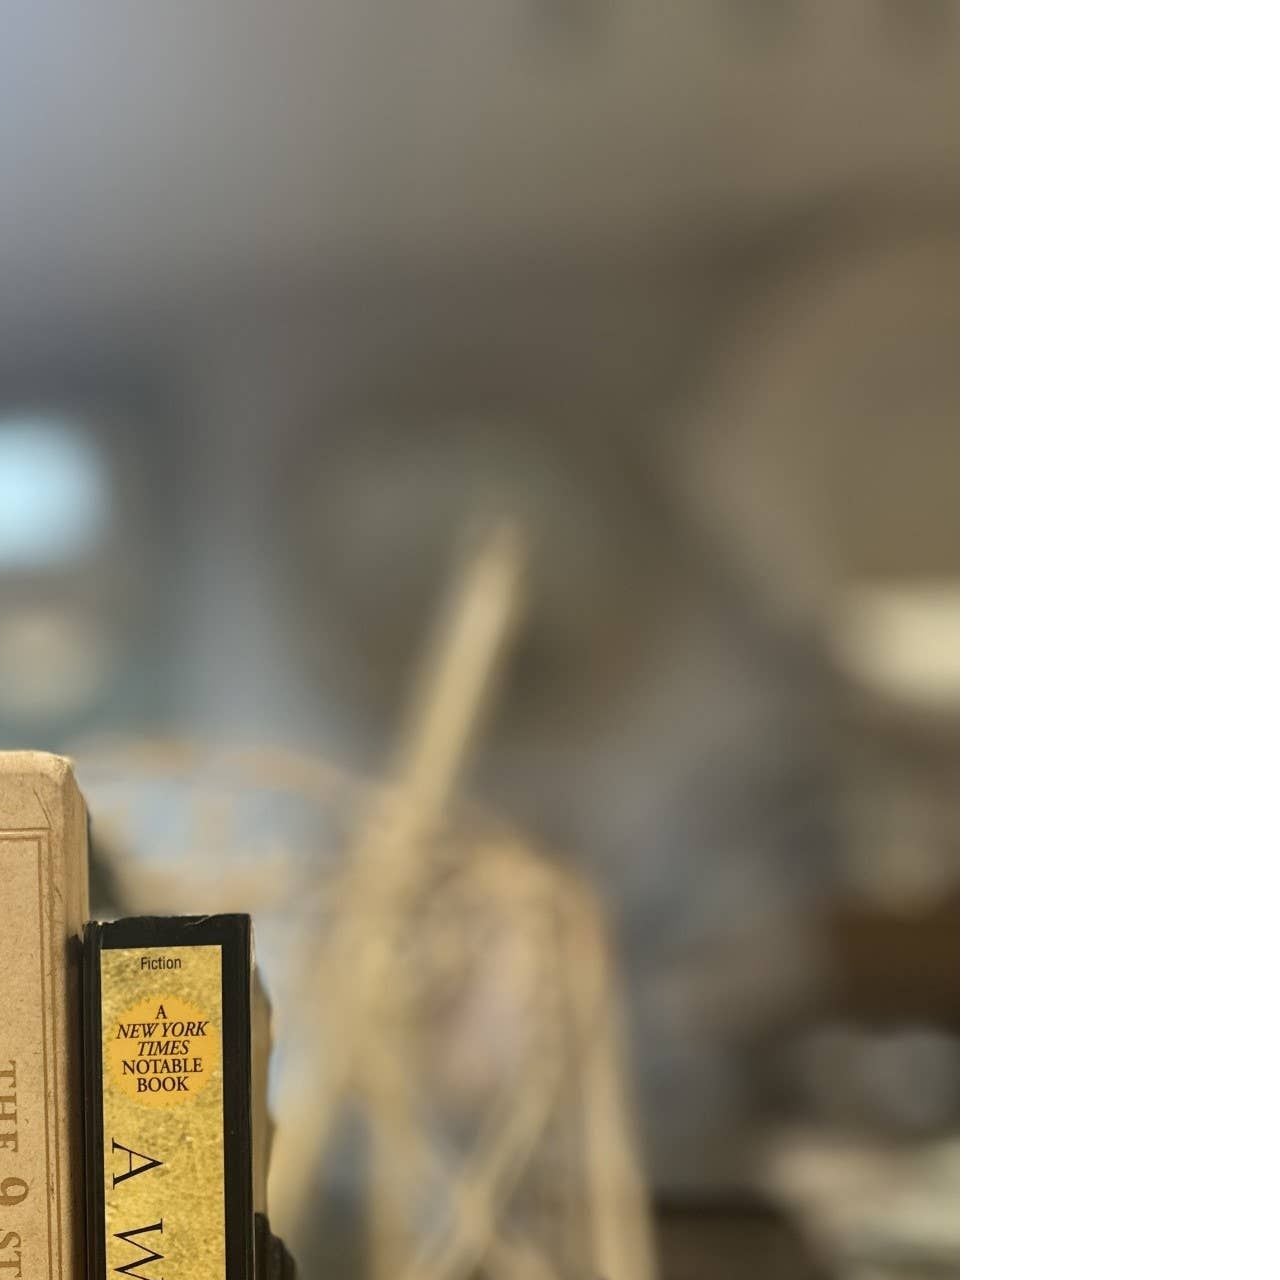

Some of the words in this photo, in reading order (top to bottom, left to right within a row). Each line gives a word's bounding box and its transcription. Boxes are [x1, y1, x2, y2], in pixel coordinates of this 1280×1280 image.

[140, 956, 182, 970] Fiction
[155, 1004, 167, 1019] A
[116, 1022, 159, 1039] NEW
[161, 1021, 210, 1038] YORK
[137, 1039, 190, 1056] TIMES
[122, 1058, 203, 1075] NOTABLE
[136, 1076, 189, 1092] BOOK
[111, 1137, 164, 1190] A
